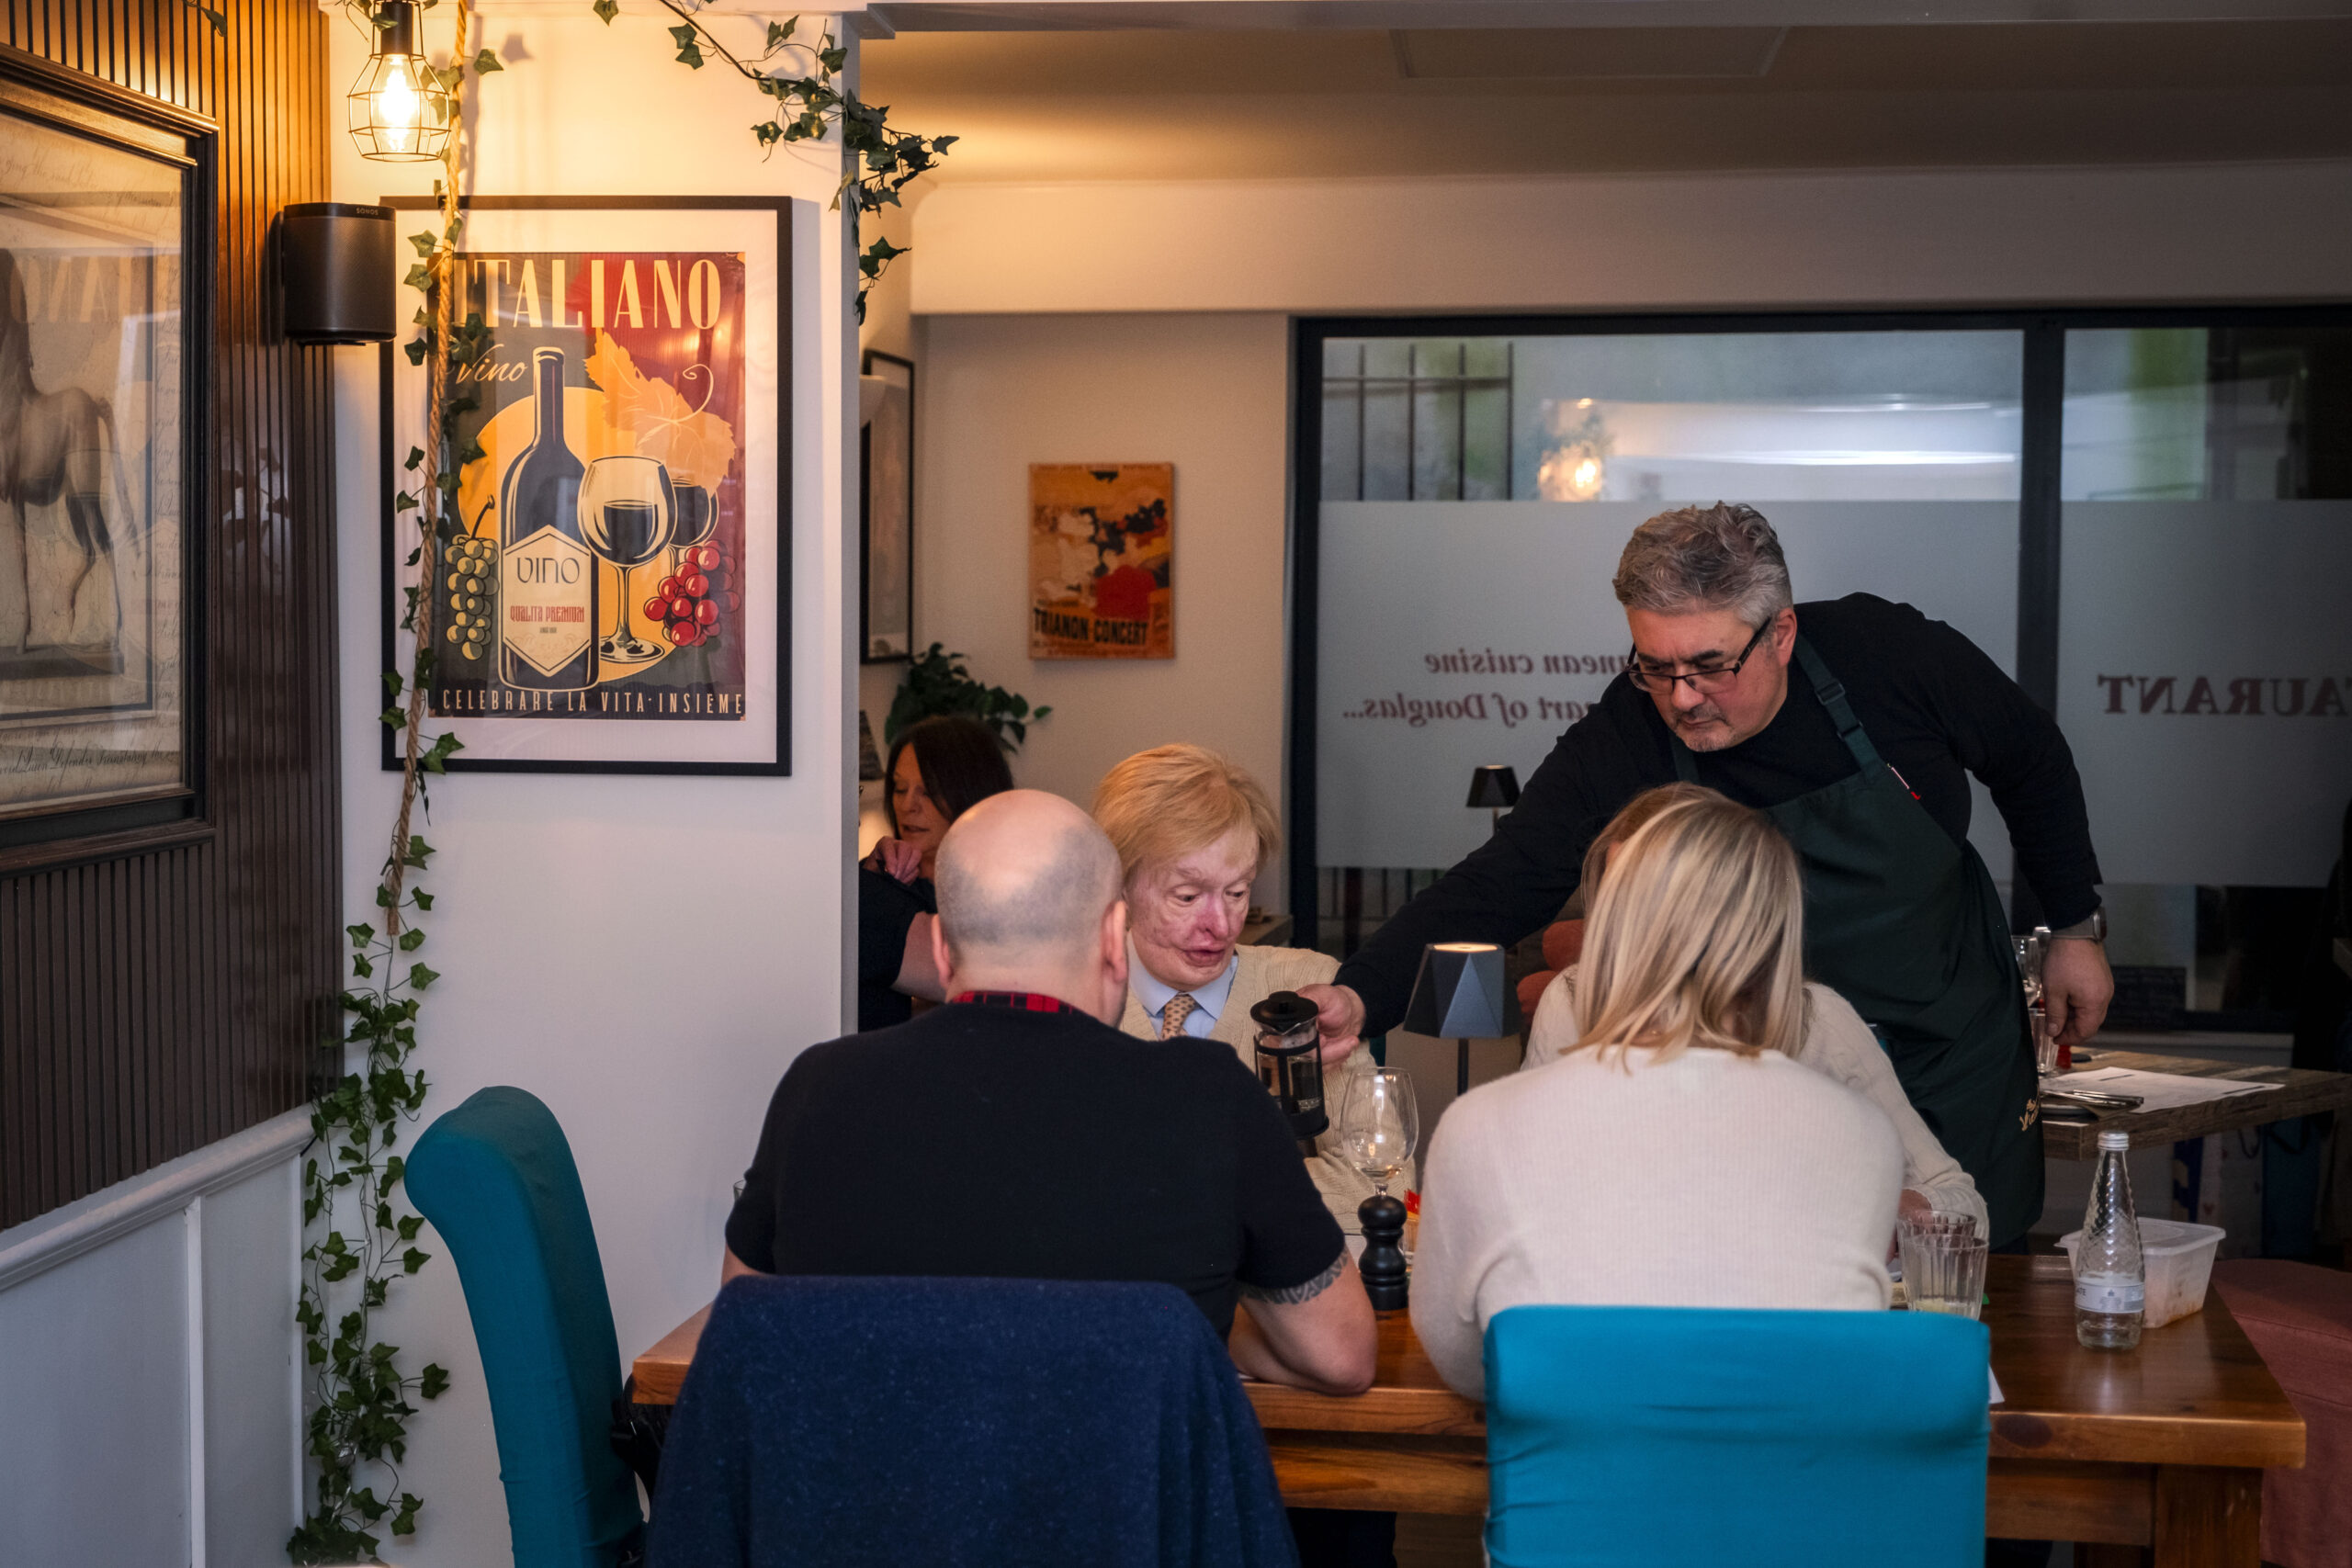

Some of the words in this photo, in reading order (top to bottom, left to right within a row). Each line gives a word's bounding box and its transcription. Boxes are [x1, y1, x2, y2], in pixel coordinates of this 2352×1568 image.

[356, 208, 379, 216] SONOS
[454, 259, 721, 330] ITALIANO
[516, 557, 581, 585] VINO
[510, 605, 543, 623] QUALITA
[546, 605, 584, 623] PREMIUM
[1094, 618, 1148, 646] CONCERT
[443, 689, 554, 711] CELEBRARE
[568, 691, 586, 712] LA
[601, 692, 644, 713] VITA
[659, 693, 742, 714] INSIEME
